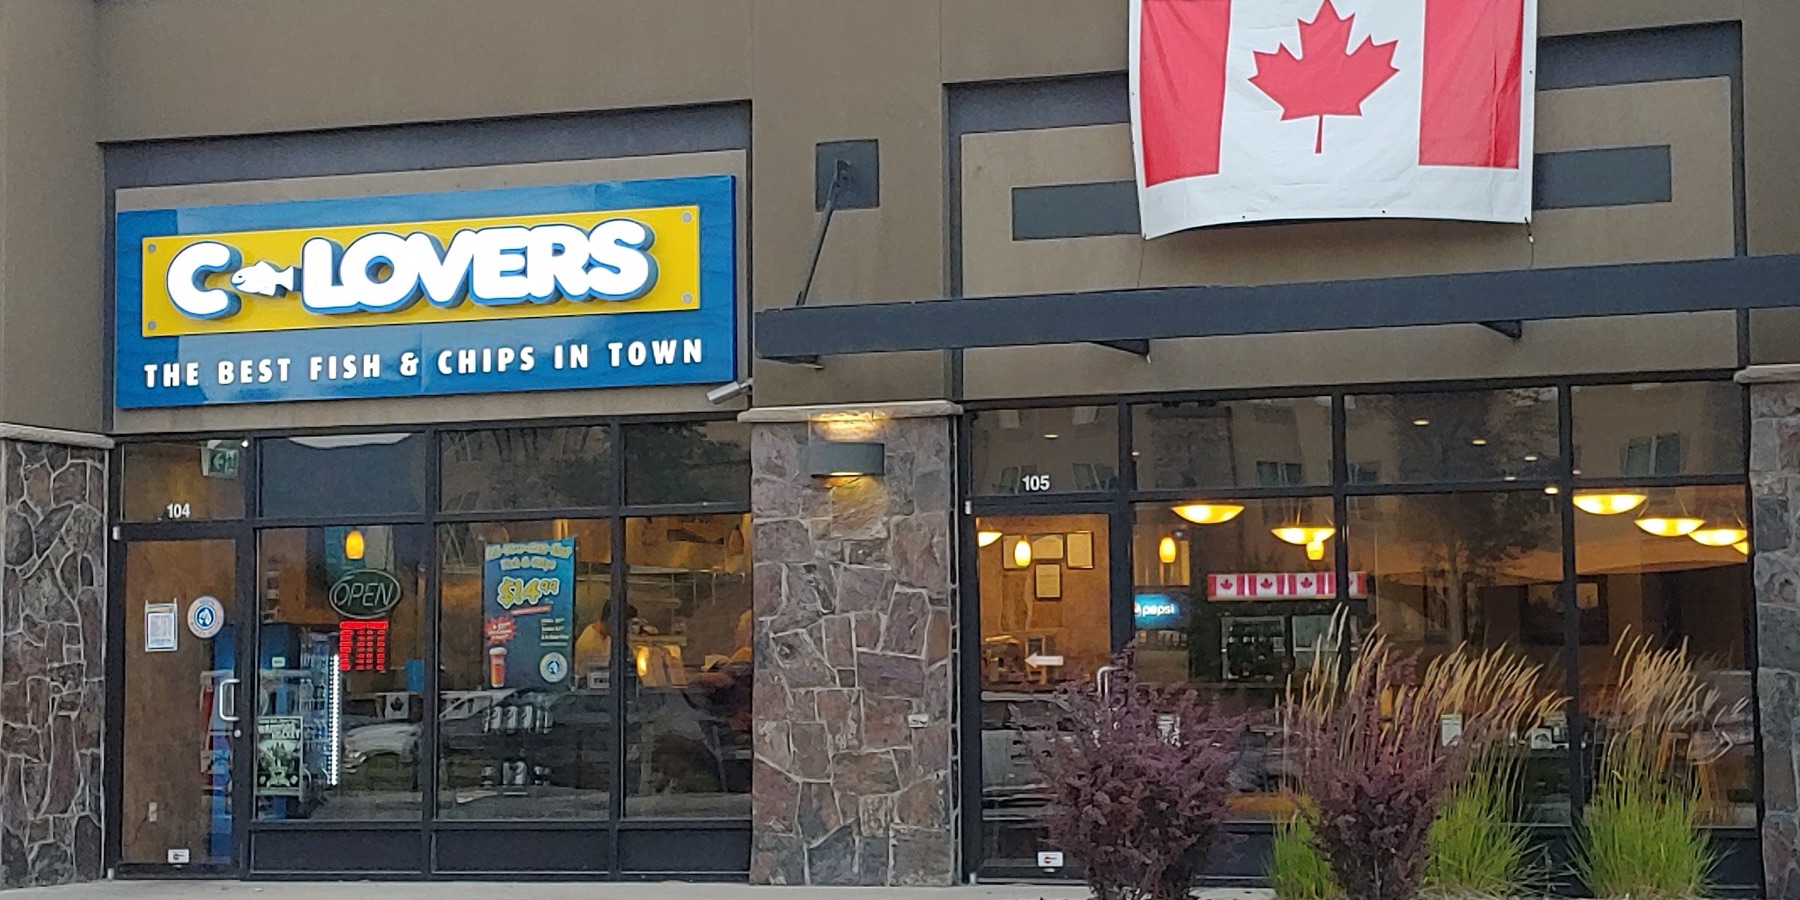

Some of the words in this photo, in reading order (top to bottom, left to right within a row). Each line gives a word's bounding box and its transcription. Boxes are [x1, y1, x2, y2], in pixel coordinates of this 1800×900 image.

[166, 241, 233, 316] C
[302, 218, 652, 311] LOVERS
[144, 362, 199, 388] THE
[217, 358, 291, 384] BEST
[309, 354, 381, 381] FISH
[399, 352, 420, 377] &
[437, 346, 536, 375] CHIPS
[554, 344, 588, 369] IN
[608, 338, 703, 367] TOWN
[1021, 474, 1051, 492] 105
[166, 503, 191, 519] 104
[333, 582, 394, 607] OPEN
